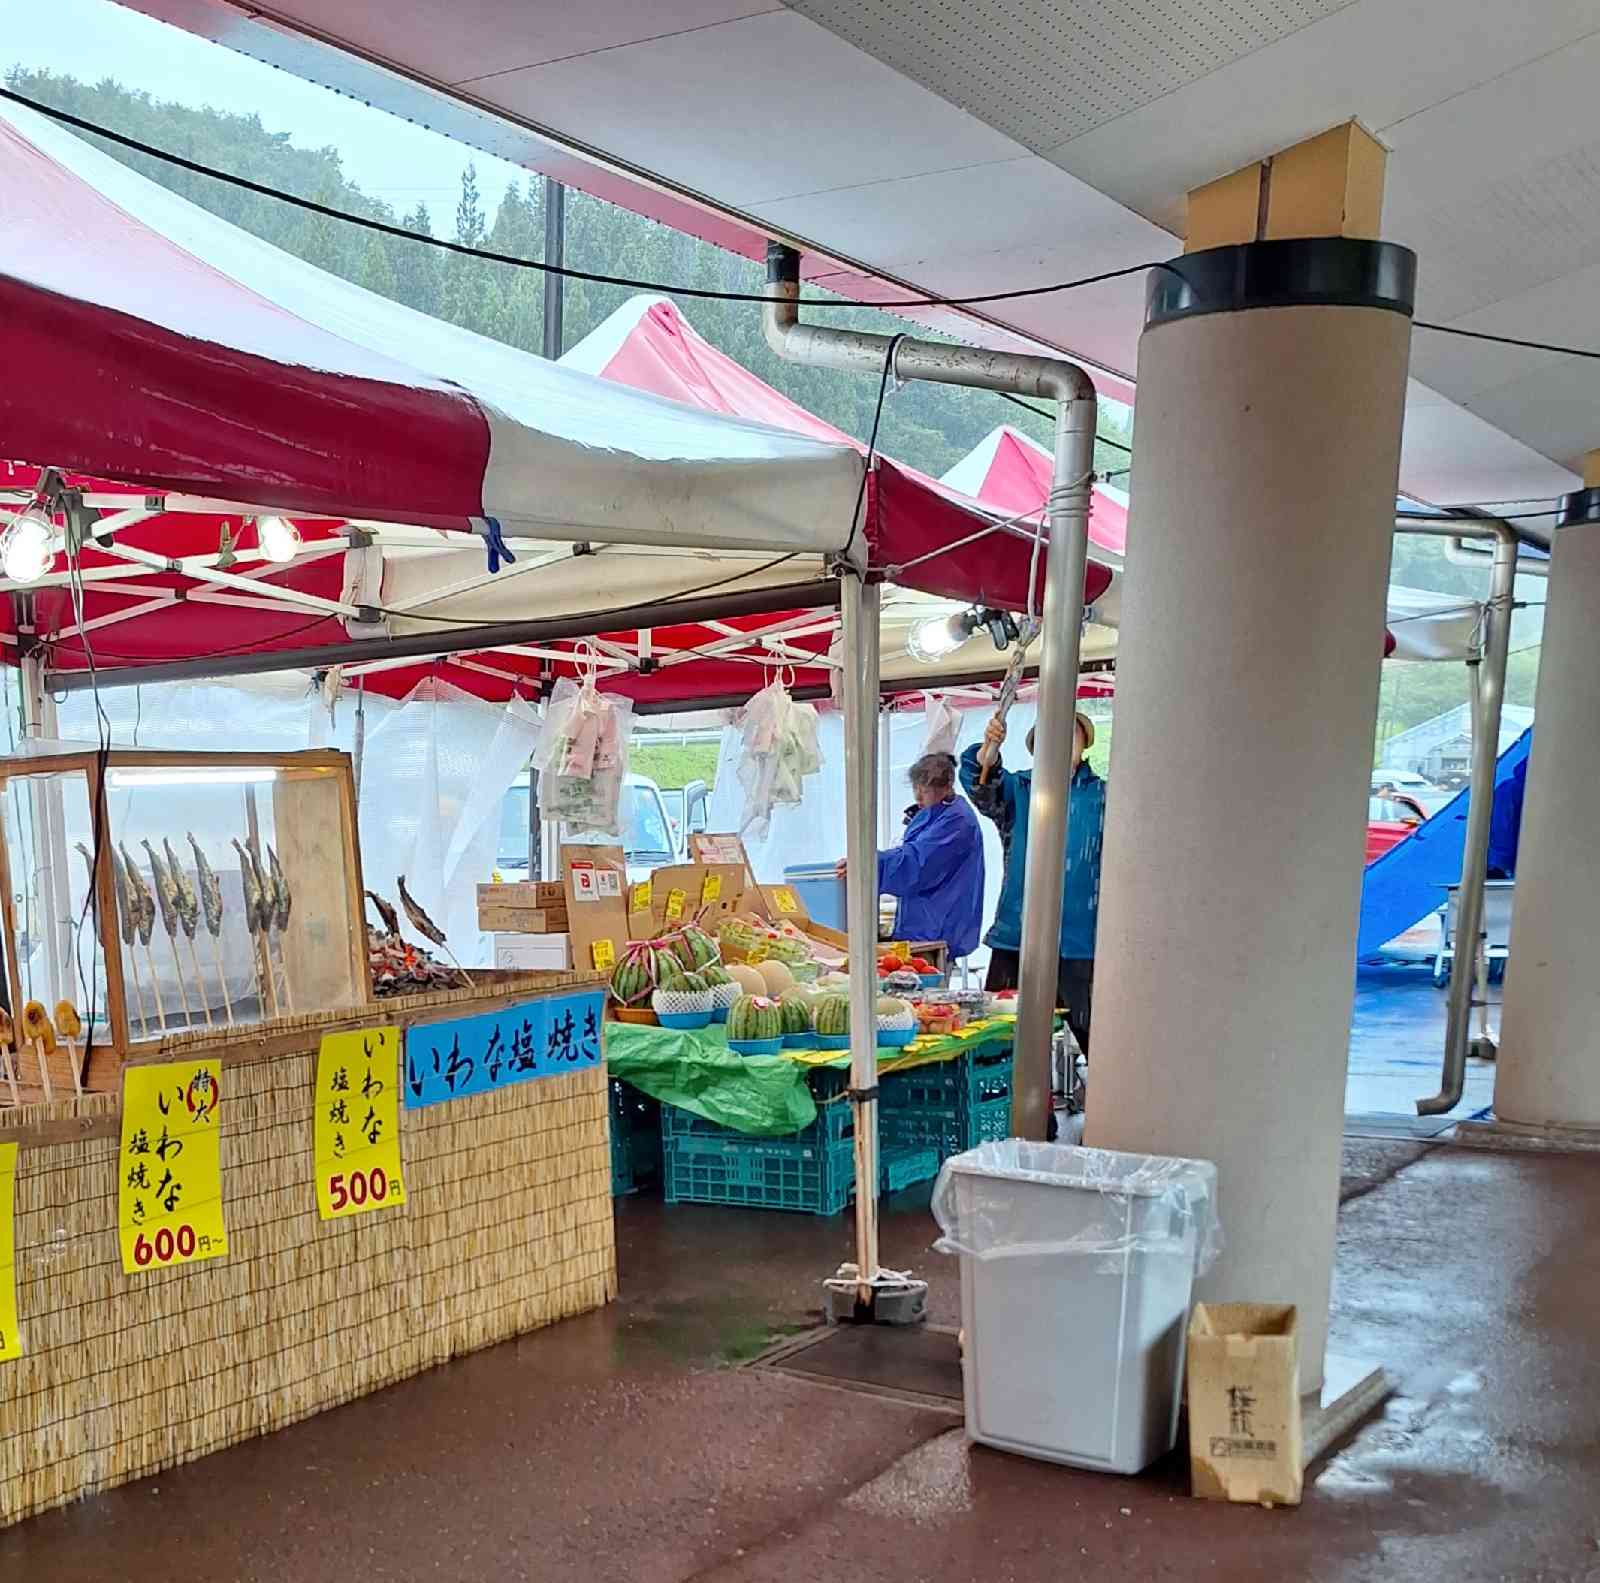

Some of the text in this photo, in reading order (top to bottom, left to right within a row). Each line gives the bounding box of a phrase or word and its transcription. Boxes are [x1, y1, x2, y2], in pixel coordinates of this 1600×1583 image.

[190, 1068, 212, 1123] 特大
[361, 1032, 385, 1144] いわな
[409, 1003, 598, 1097] いわな塩焼き
[155, 1086, 184, 1212] いわな
[329, 1066, 350, 1159] 塩焼き
[127, 1128, 151, 1226] 塩焼き
[330, 1167, 400, 1211] 500円
